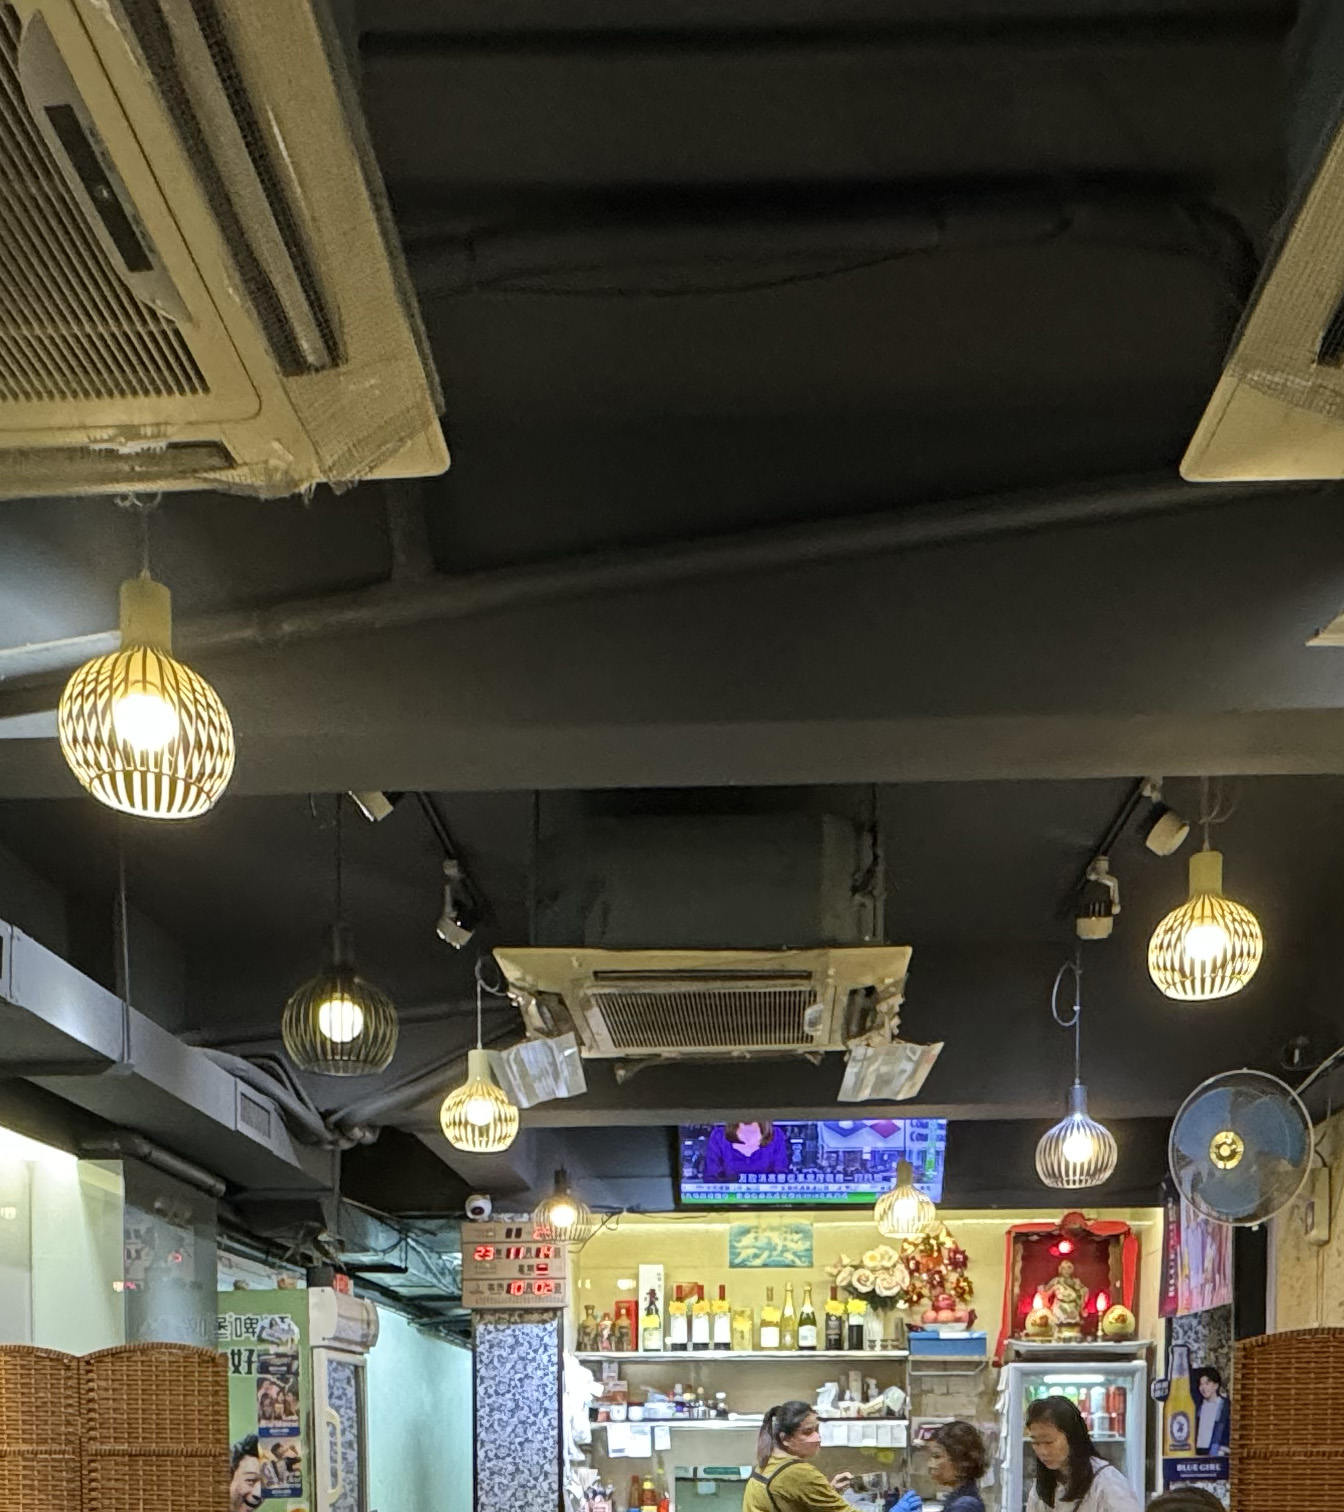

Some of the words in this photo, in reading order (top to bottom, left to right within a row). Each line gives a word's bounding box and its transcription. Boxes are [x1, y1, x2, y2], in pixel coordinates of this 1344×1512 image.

[474, 1244, 495, 1261] 23
[508, 1245, 525, 1260] 11
[533, 1280, 555, 1296] 02
[1176, 1463, 1198, 1472] BLUE
[1199, 1463, 1222, 1472] GIRL
